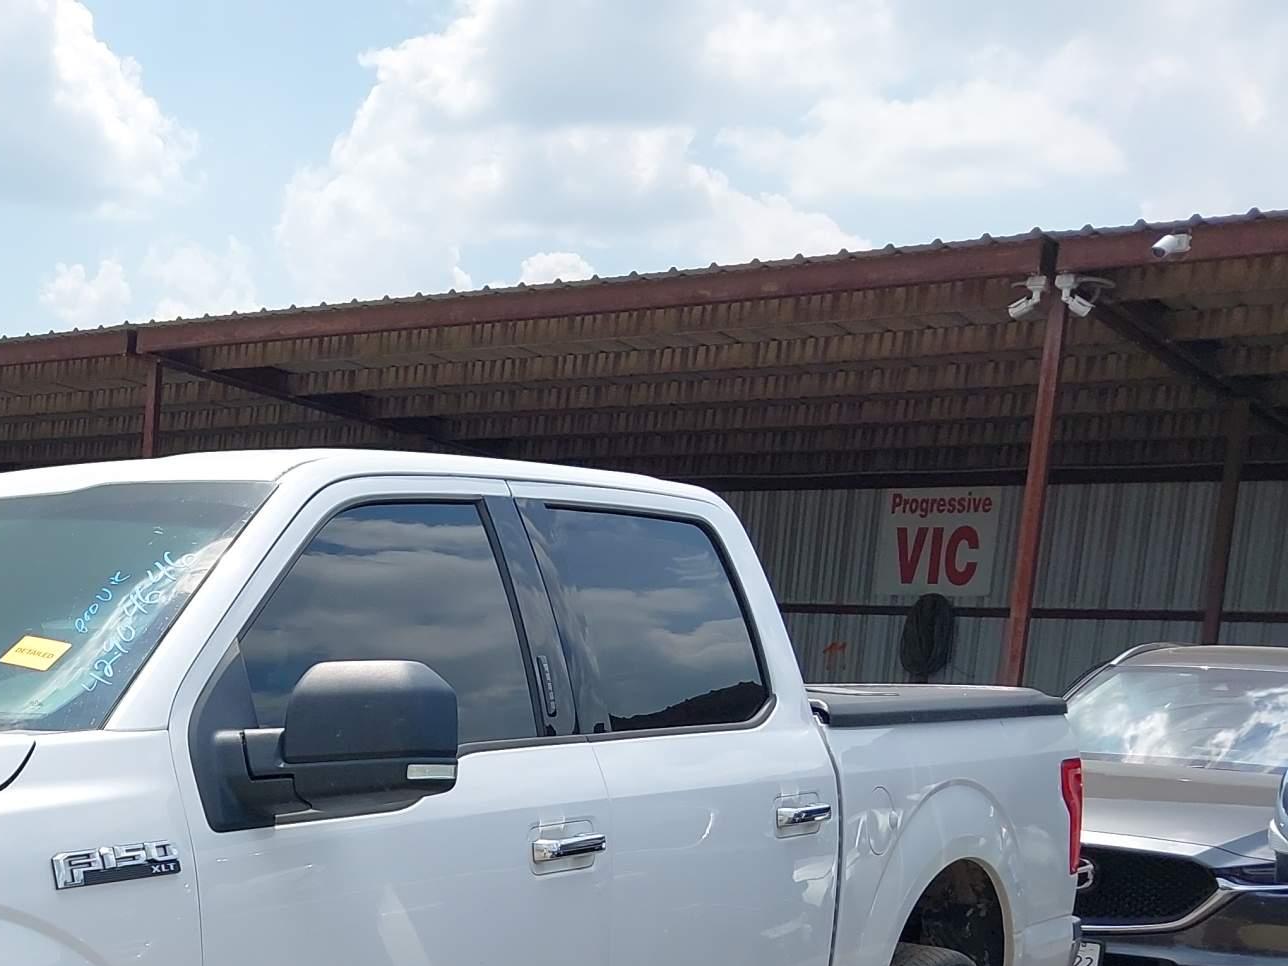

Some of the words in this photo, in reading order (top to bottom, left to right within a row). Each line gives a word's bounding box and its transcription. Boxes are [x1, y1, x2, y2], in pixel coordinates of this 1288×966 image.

[891, 491, 993, 518] Progressive
[896, 525, 980, 586] VIC
[81, 551, 196, 692] 42904646
[15, 647, 55, 659] DETAILED
[151, 862, 176, 874] XLT
